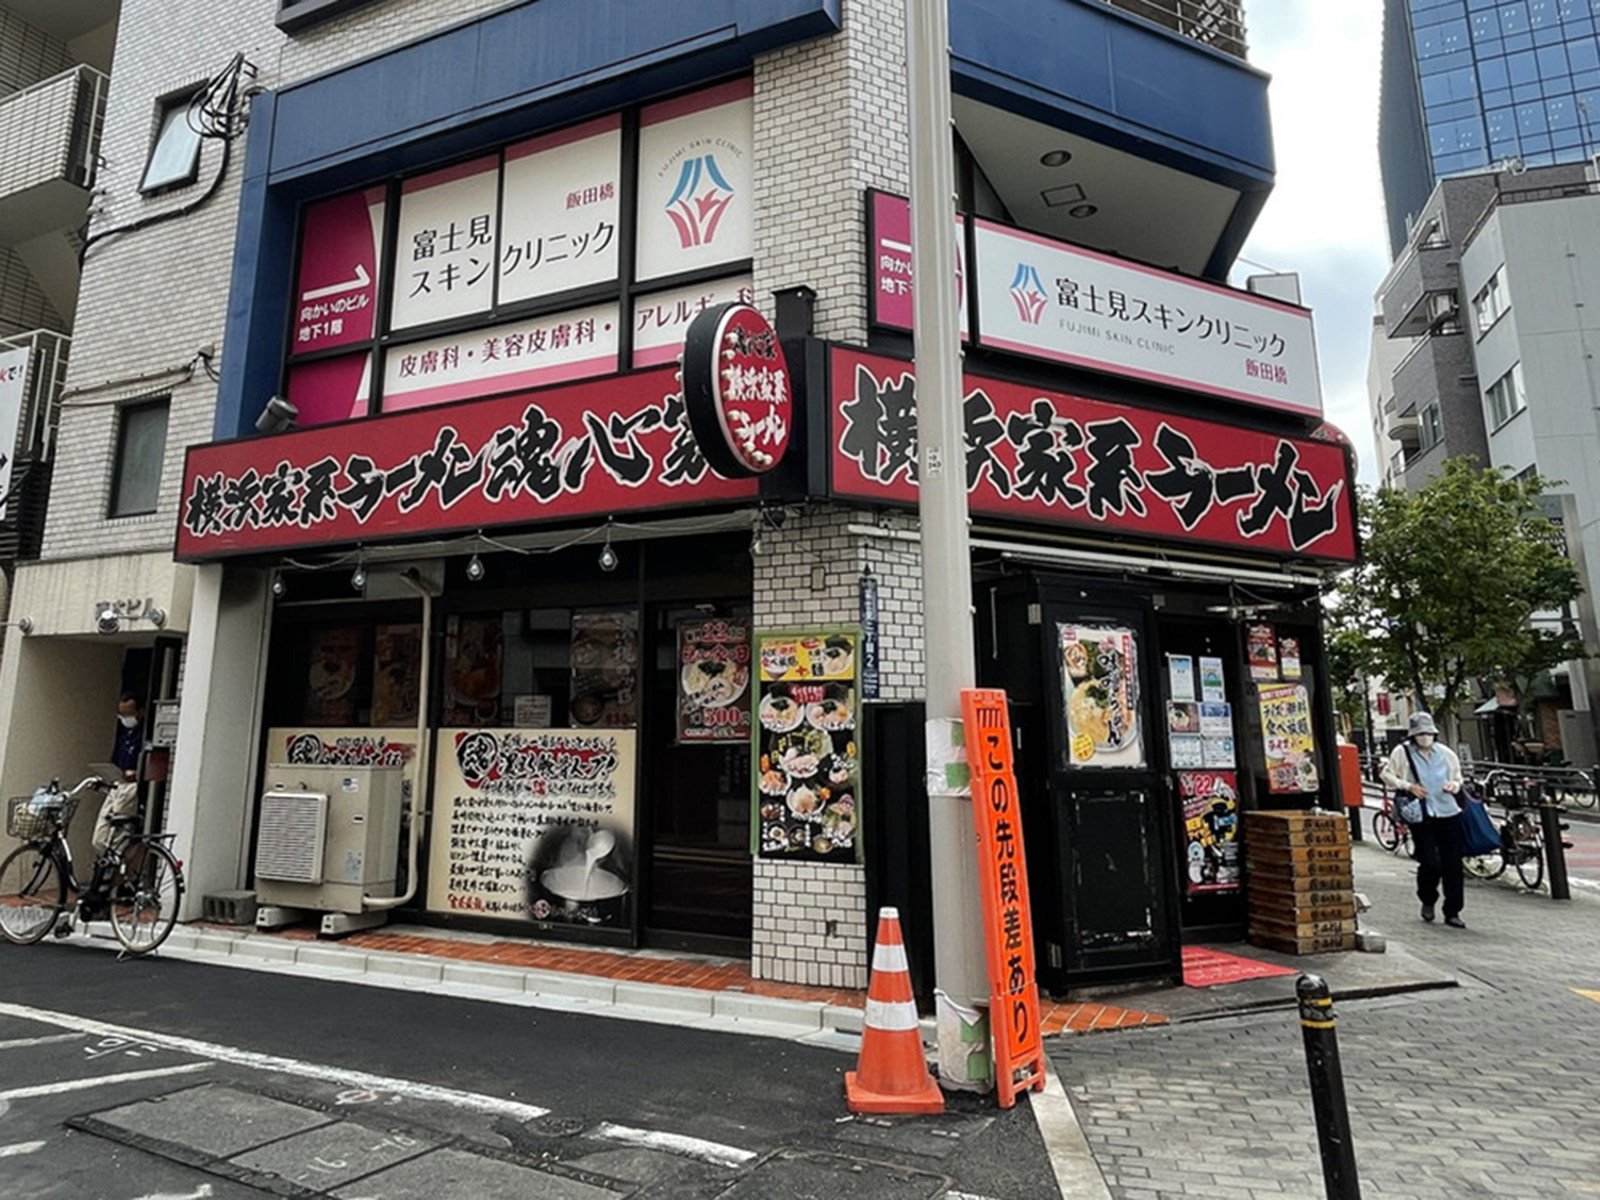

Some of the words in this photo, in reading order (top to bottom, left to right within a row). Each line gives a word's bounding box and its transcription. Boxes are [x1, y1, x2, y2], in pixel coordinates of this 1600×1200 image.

[566, 182, 615, 210] 飯田橋
[412, 213, 493, 263] 富士見
[408, 221, 615, 299] スキンクリニック
[880, 277, 913, 296] 地下
[300, 293, 370, 323] 向かいのビル
[1055, 277, 1286, 358] 富士見スキンクリニック
[298, 319, 343, 342] 地下1階
[1059, 319, 1101, 338] FUJIMI
[1105, 329, 1133, 346] SKIN
[1137, 336, 1176, 356] CLINIC
[1245, 358, 1288, 385] 飯田橋
[839, 363, 1343, 552] 横浜家系ラーメン
[987, 736, 1029, 1045] この先段差あり
